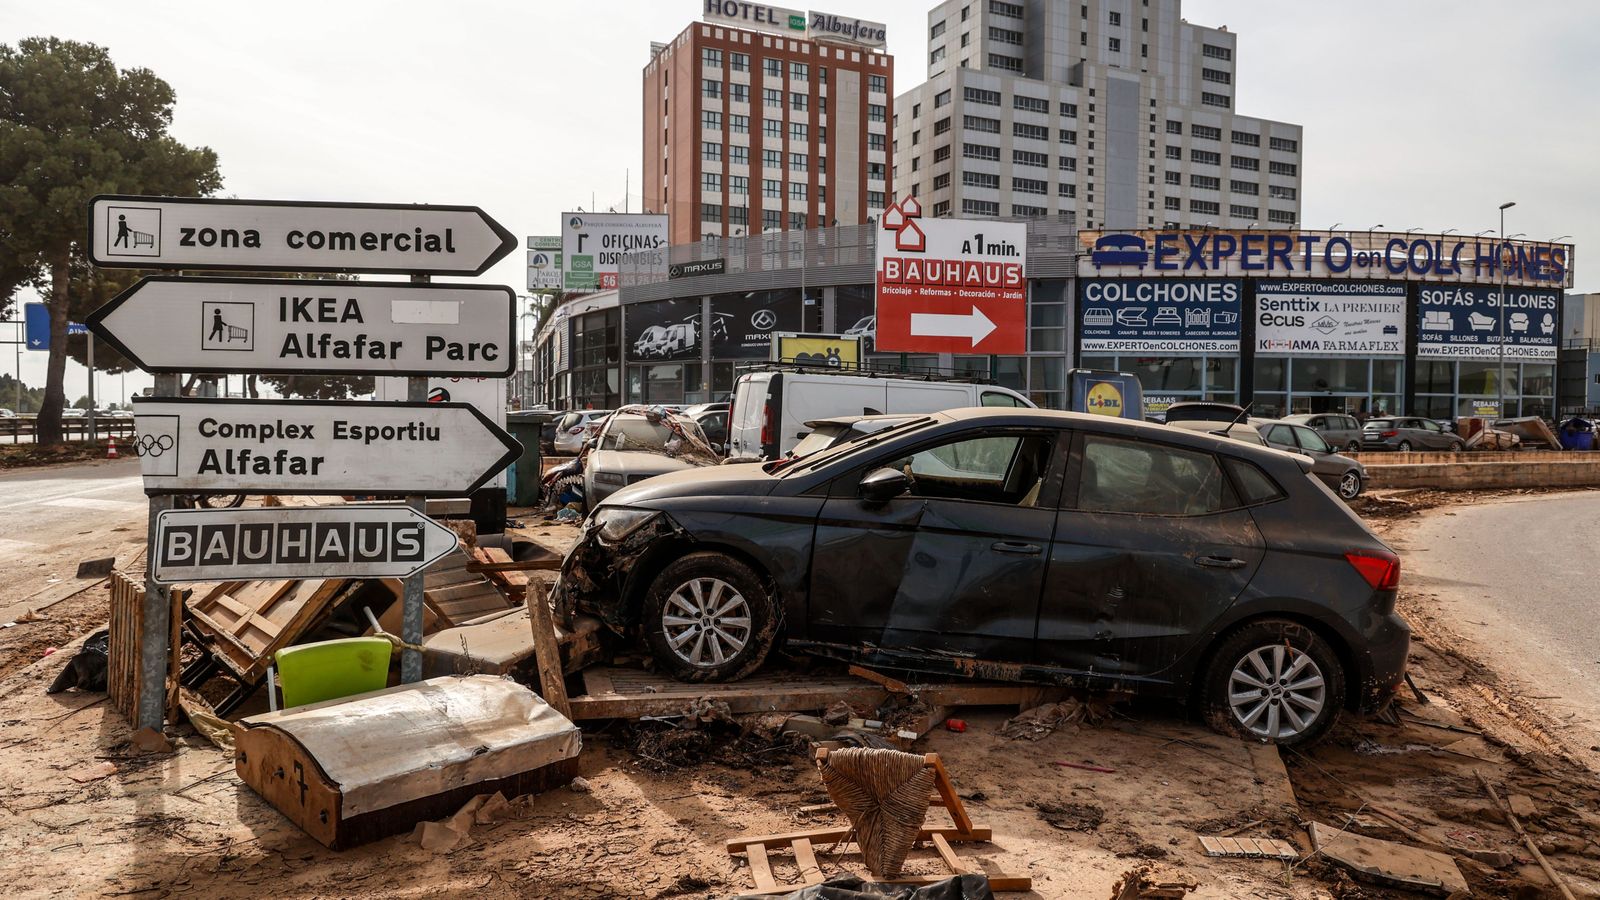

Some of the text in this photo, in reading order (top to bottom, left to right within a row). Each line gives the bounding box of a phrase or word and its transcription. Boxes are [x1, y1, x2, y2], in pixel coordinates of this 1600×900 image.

[706, 0, 780, 25] HOTEL
[811, 13, 886, 41] Albufera
[179, 226, 456, 253] zona comercial
[602, 234, 659, 249] OFICINAS
[961, 233, 1021, 256] A 1 min.
[599, 252, 663, 266] DISPONIBLES
[684, 262, 723, 273] MAXUS
[1155, 235, 1565, 281] EXPERTO en COLCHONES
[885, 260, 1020, 285] BAUHAUS
[882, 286, 912, 295] Bricolaje
[920, 287, 952, 296] Reformas
[959, 289, 996, 298] Decoración
[1086, 283, 1238, 302] COLCHONES
[1260, 283, 1404, 294] www.EXPERTOenCOLCHONES.com
[1260, 297, 1320, 312] Senttix
[1324, 302, 1401, 313] LA PREMIER
[1421, 289, 1474, 306] SOFÁS
[1487, 293, 1556, 309] SILLONES
[279, 296, 365, 324] IKEA
[1260, 312, 1305, 327] ecus
[1083, 342, 1239, 351] www.EXPERTOenCOLCHONES.com
[1323, 340, 1400, 351] FARMAFLEX
[1422, 333, 1443, 341] SOFÁS
[1519, 336, 1553, 344] BALANCINES
[279, 333, 499, 362] Alfafar Parc
[198, 417, 441, 446] Complex Esportiu
[197, 449, 325, 476] Alfafar
[165, 525, 422, 563] BAUHAUS
